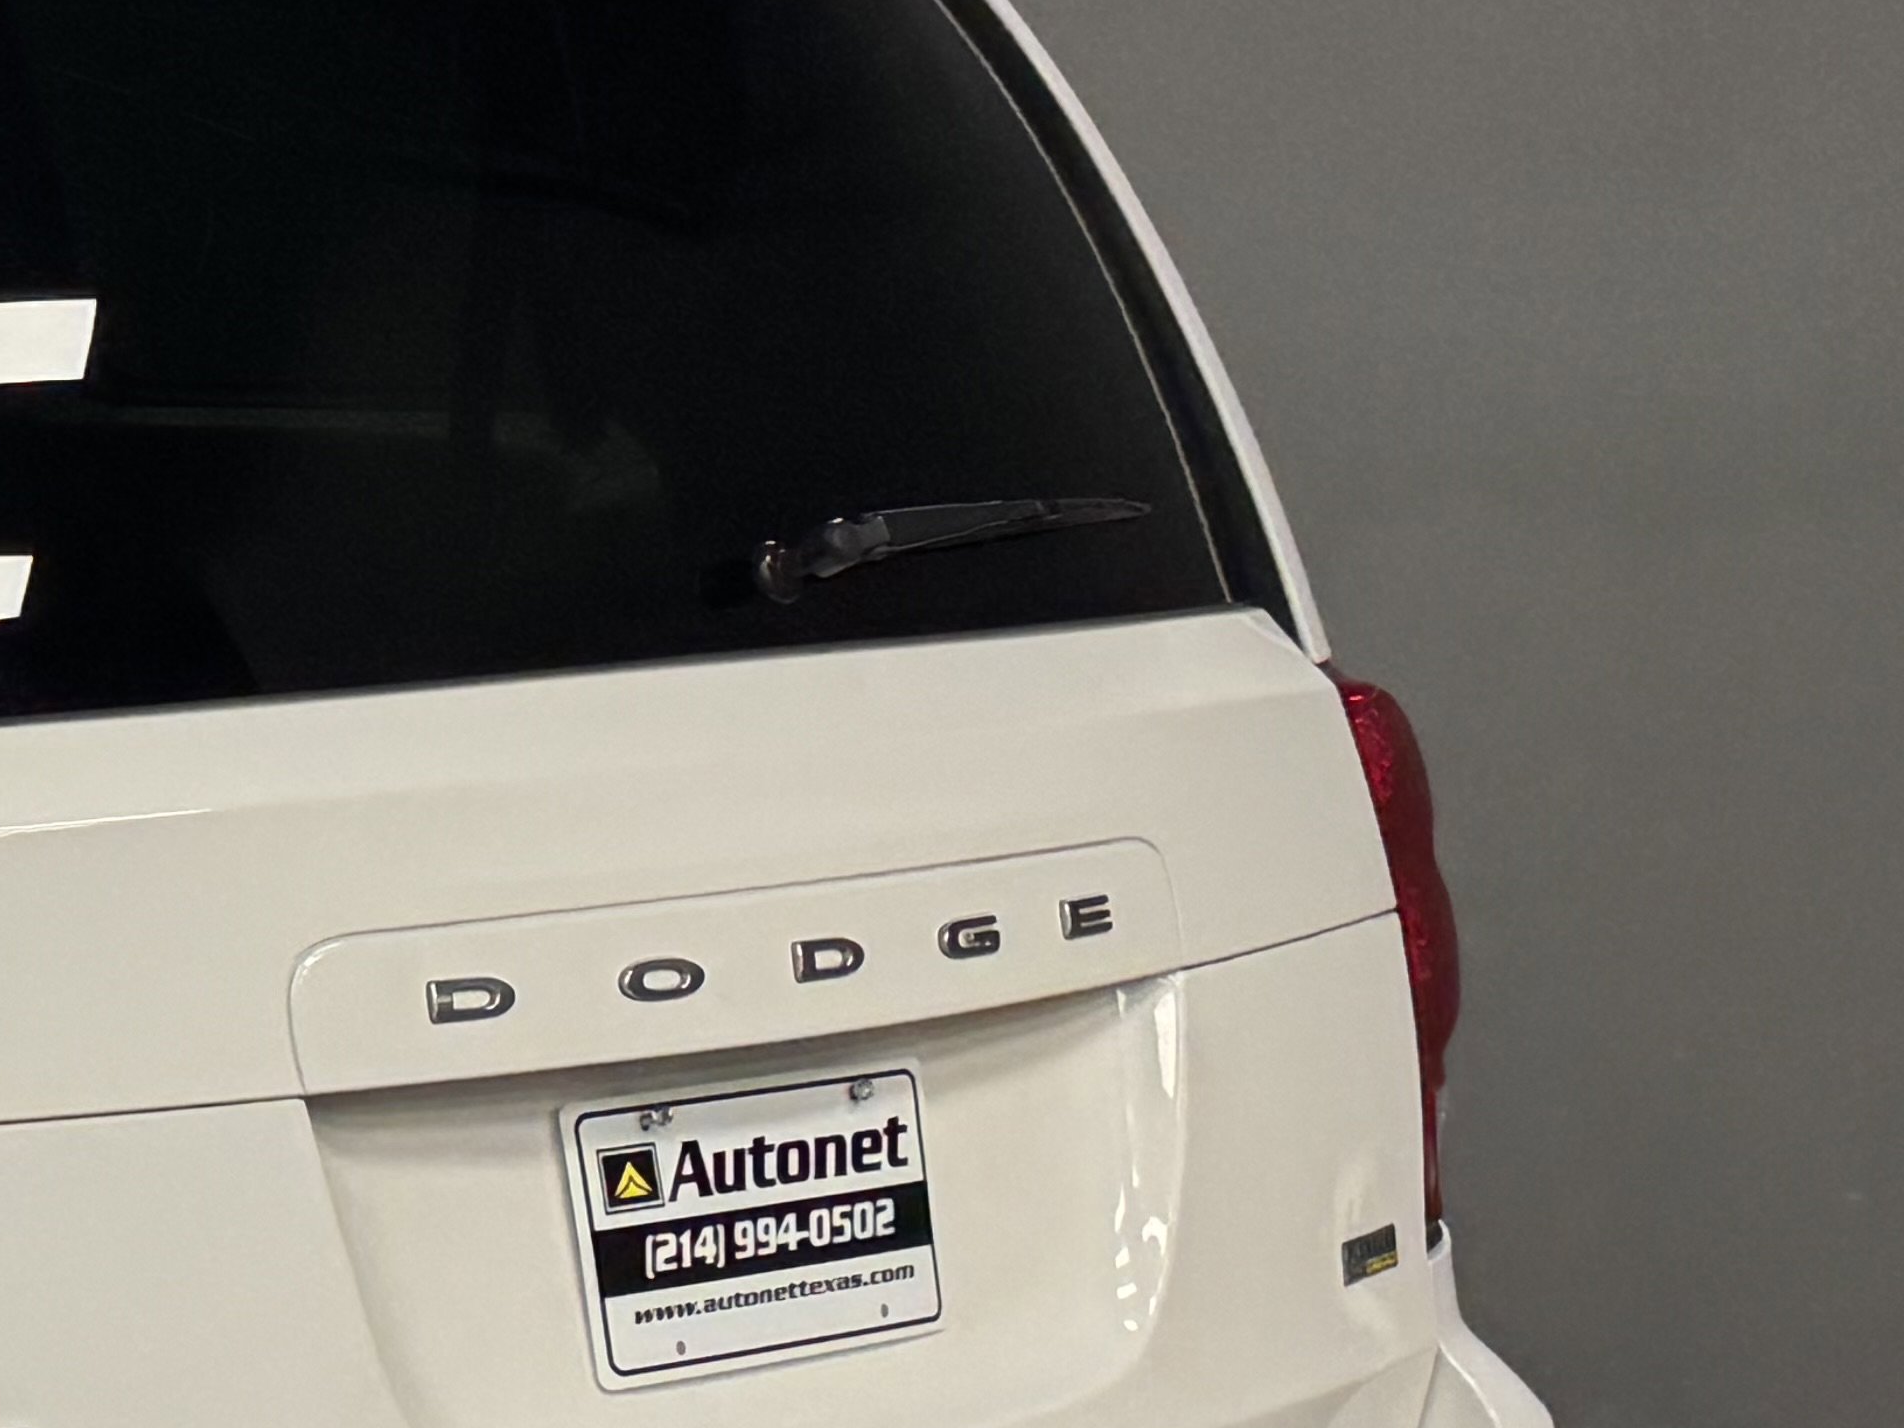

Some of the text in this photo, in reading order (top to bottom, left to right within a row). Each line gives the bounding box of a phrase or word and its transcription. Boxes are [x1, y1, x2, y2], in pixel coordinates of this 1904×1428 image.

[426, 894, 1113, 1024] DODGE
[668, 1116, 908, 1202] Autonet
[645, 1198, 895, 1279] (214) 994-0502
[634, 1264, 915, 1324] www.autonettexas.com
